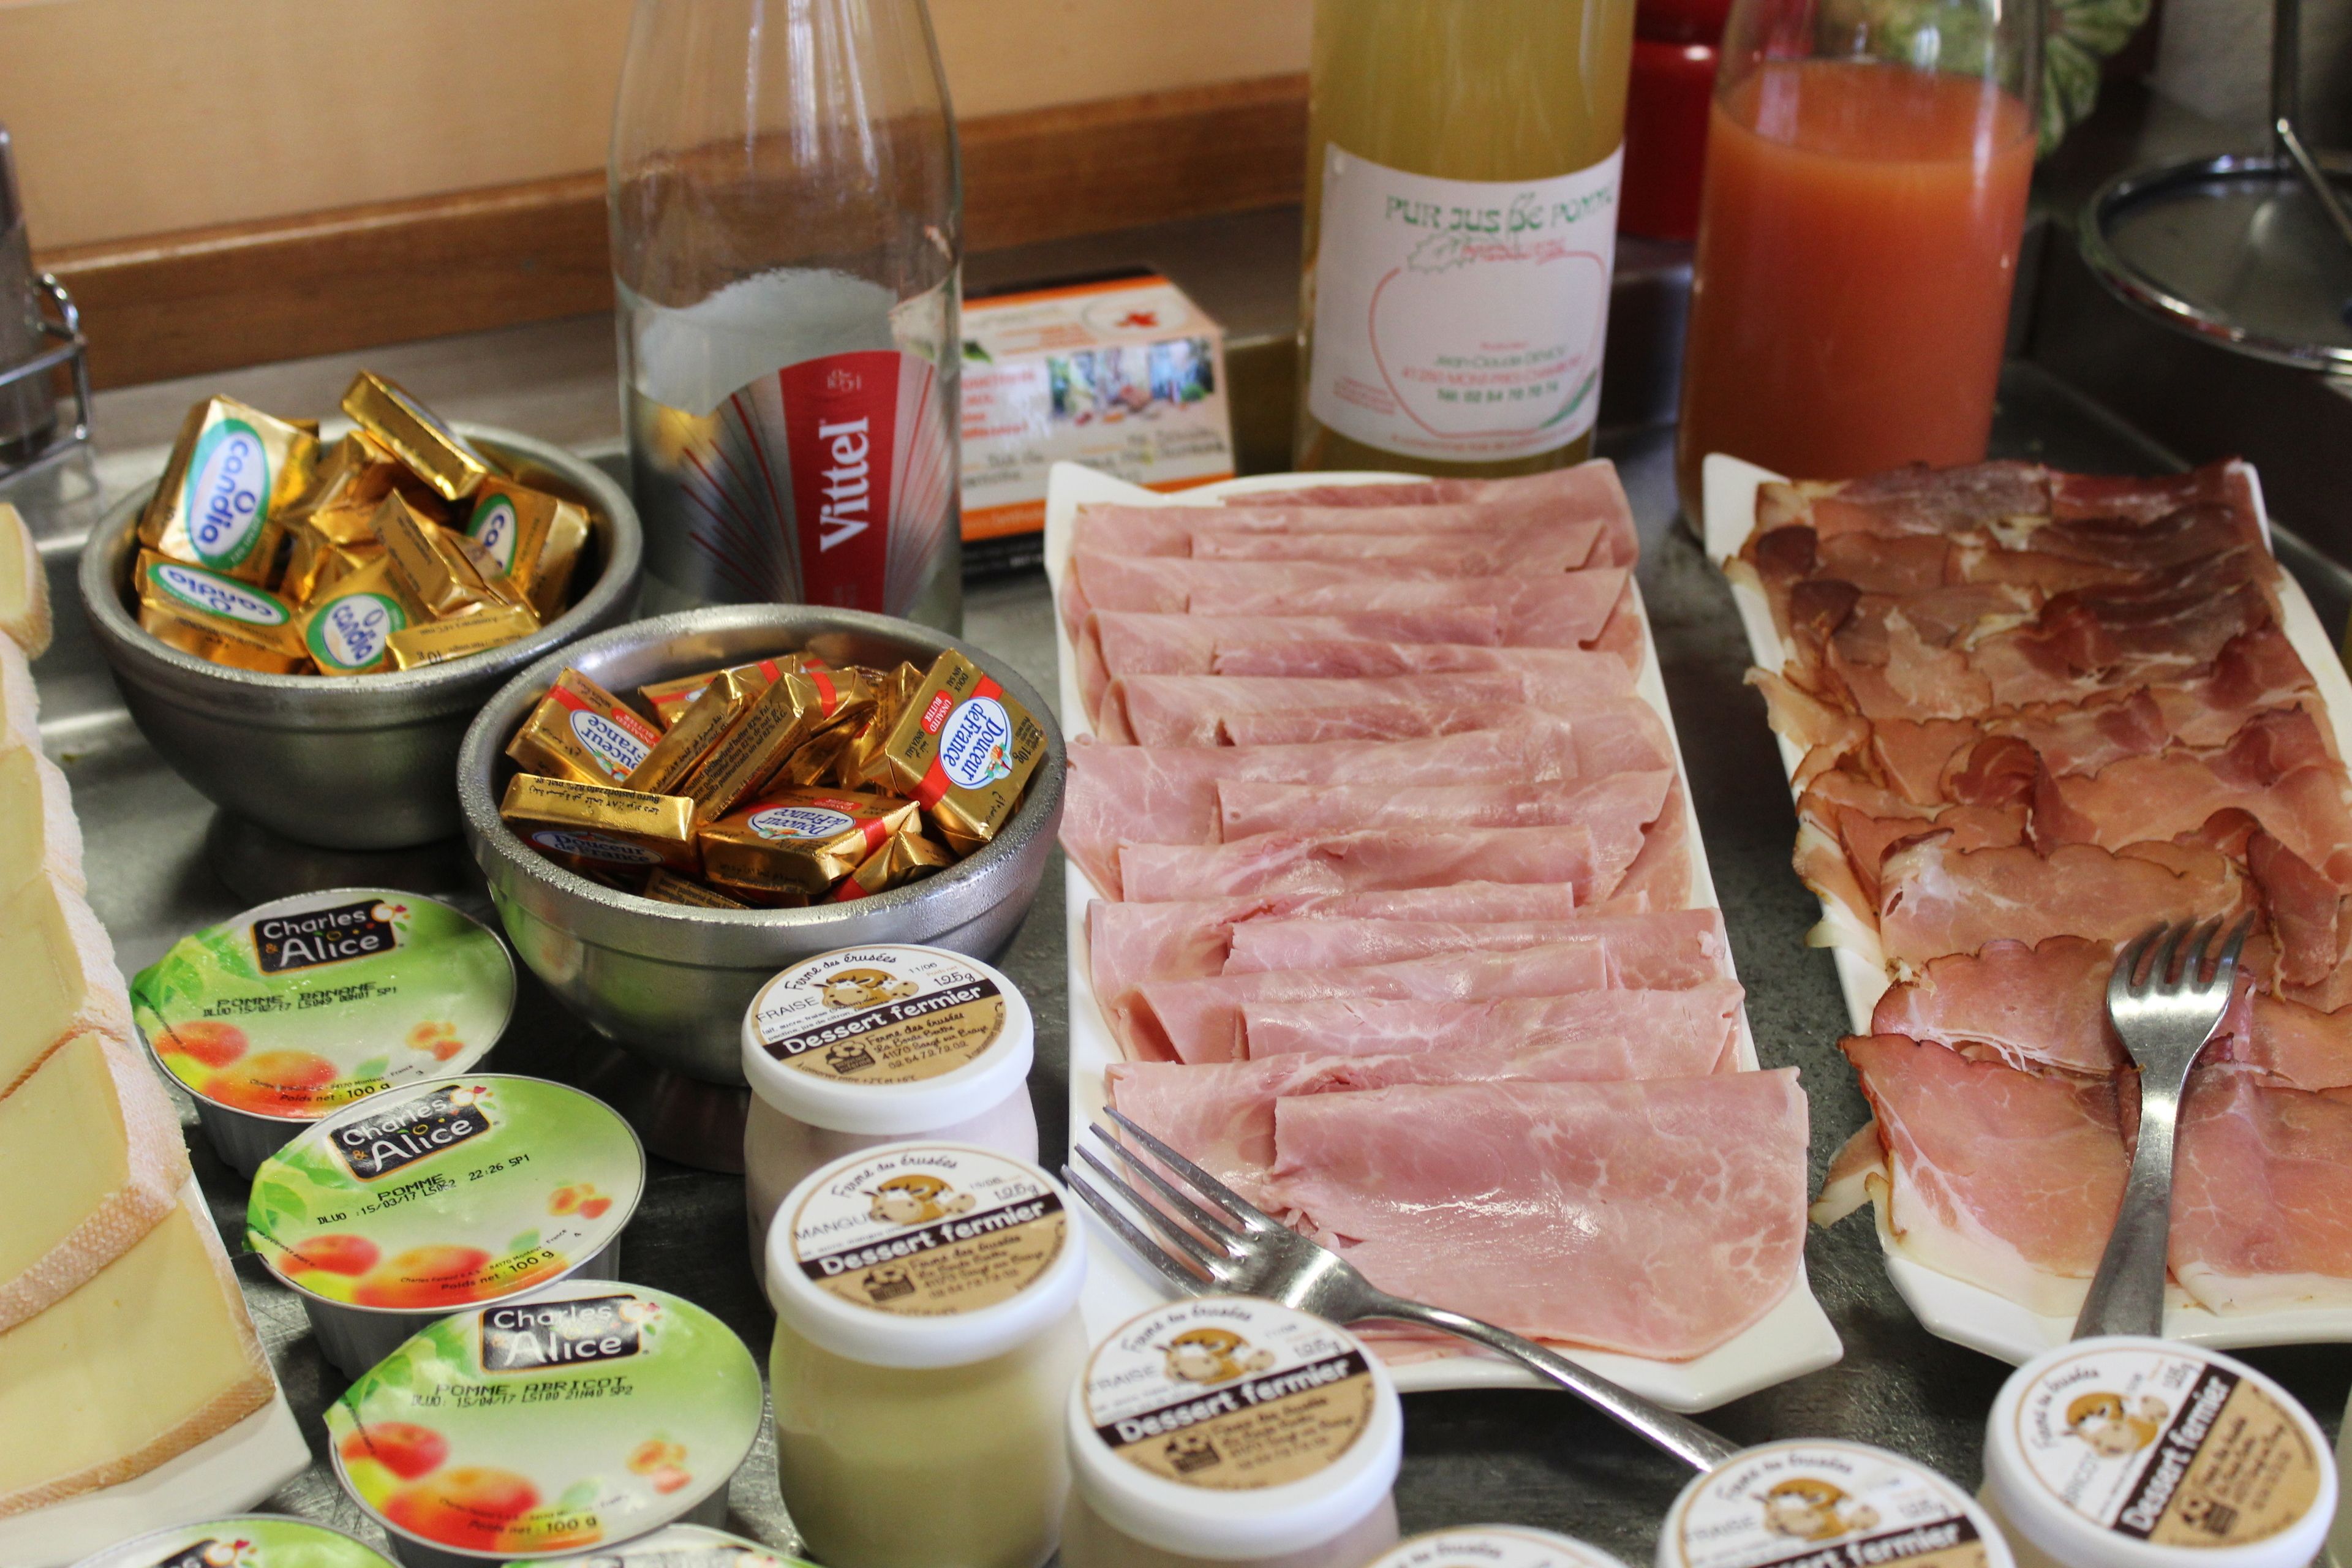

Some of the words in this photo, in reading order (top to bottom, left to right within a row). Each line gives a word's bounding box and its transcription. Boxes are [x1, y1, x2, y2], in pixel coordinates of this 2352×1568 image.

[1386, 194, 1440, 227] PUR
[199, 440, 248, 544] candia
[819, 417, 869, 552] Vittel
[167, 570, 272, 616] candia
[333, 605, 372, 661] candia
[952, 672, 970, 693] DOUX
[923, 696, 943, 723] BUTTER
[928, 698, 952, 733] UNSALTED
[731, 726, 750, 745] butter
[910, 729, 925, 747] SENZA
[956, 717, 1006, 783] Douceur
[904, 744, 916, 758] SALE
[1011, 744, 1033, 766] 10g
[586, 785, 635, 799] pastorizzato
[636, 793, 659, 803] Burro
[757, 814, 827, 836] Douceur
[263, 910, 366, 939] Charles
[279, 935, 379, 967] Alice
[785, 966, 821, 991] Ferme
[823, 960, 840, 969] des
[934, 972, 975, 986] 125g
[755, 997, 820, 1023] FRAISE
[783, 1013, 888, 1054] Dessert
[890, 986, 981, 1020] fermier
[865, 1030, 901, 1045] Ferme
[905, 1023, 924, 1034] des
[883, 1046, 911, 1060] 41170
[390, 1065, 413, 1076] France
[347, 1085, 375, 1098] 100
[342, 1099, 447, 1146] Charles
[371, 1118, 473, 1172] Alice
[317, 1212, 347, 1225] DLUO
[469, 1163, 503, 1181] 22:26
[378, 1174, 444, 1201] POMME
[831, 1169, 873, 1198] Ferme
[877, 1163, 896, 1172] des
[819, 1231, 937, 1276] Dessert
[940, 1202, 1045, 1243] fermier
[480, 1273, 500, 1284] net
[508, 1257, 539, 1273] 100
[541, 1250, 554, 1259] g
[494, 1305, 611, 1329] Charles
[504, 1331, 622, 1366] Alice
[435, 1383, 510, 1397] POMME
[524, 1376, 627, 1393] ABRICOT
[1114, 1387, 1234, 1444] Dessert
[1241, 1358, 1349, 1406] fermier
[2120, 1446, 2191, 1531] Dessert
[2169, 1374, 2230, 1450] fermier
[548, 1519, 578, 1533] 100
[1845, 1523, 1960, 1566] fermier
